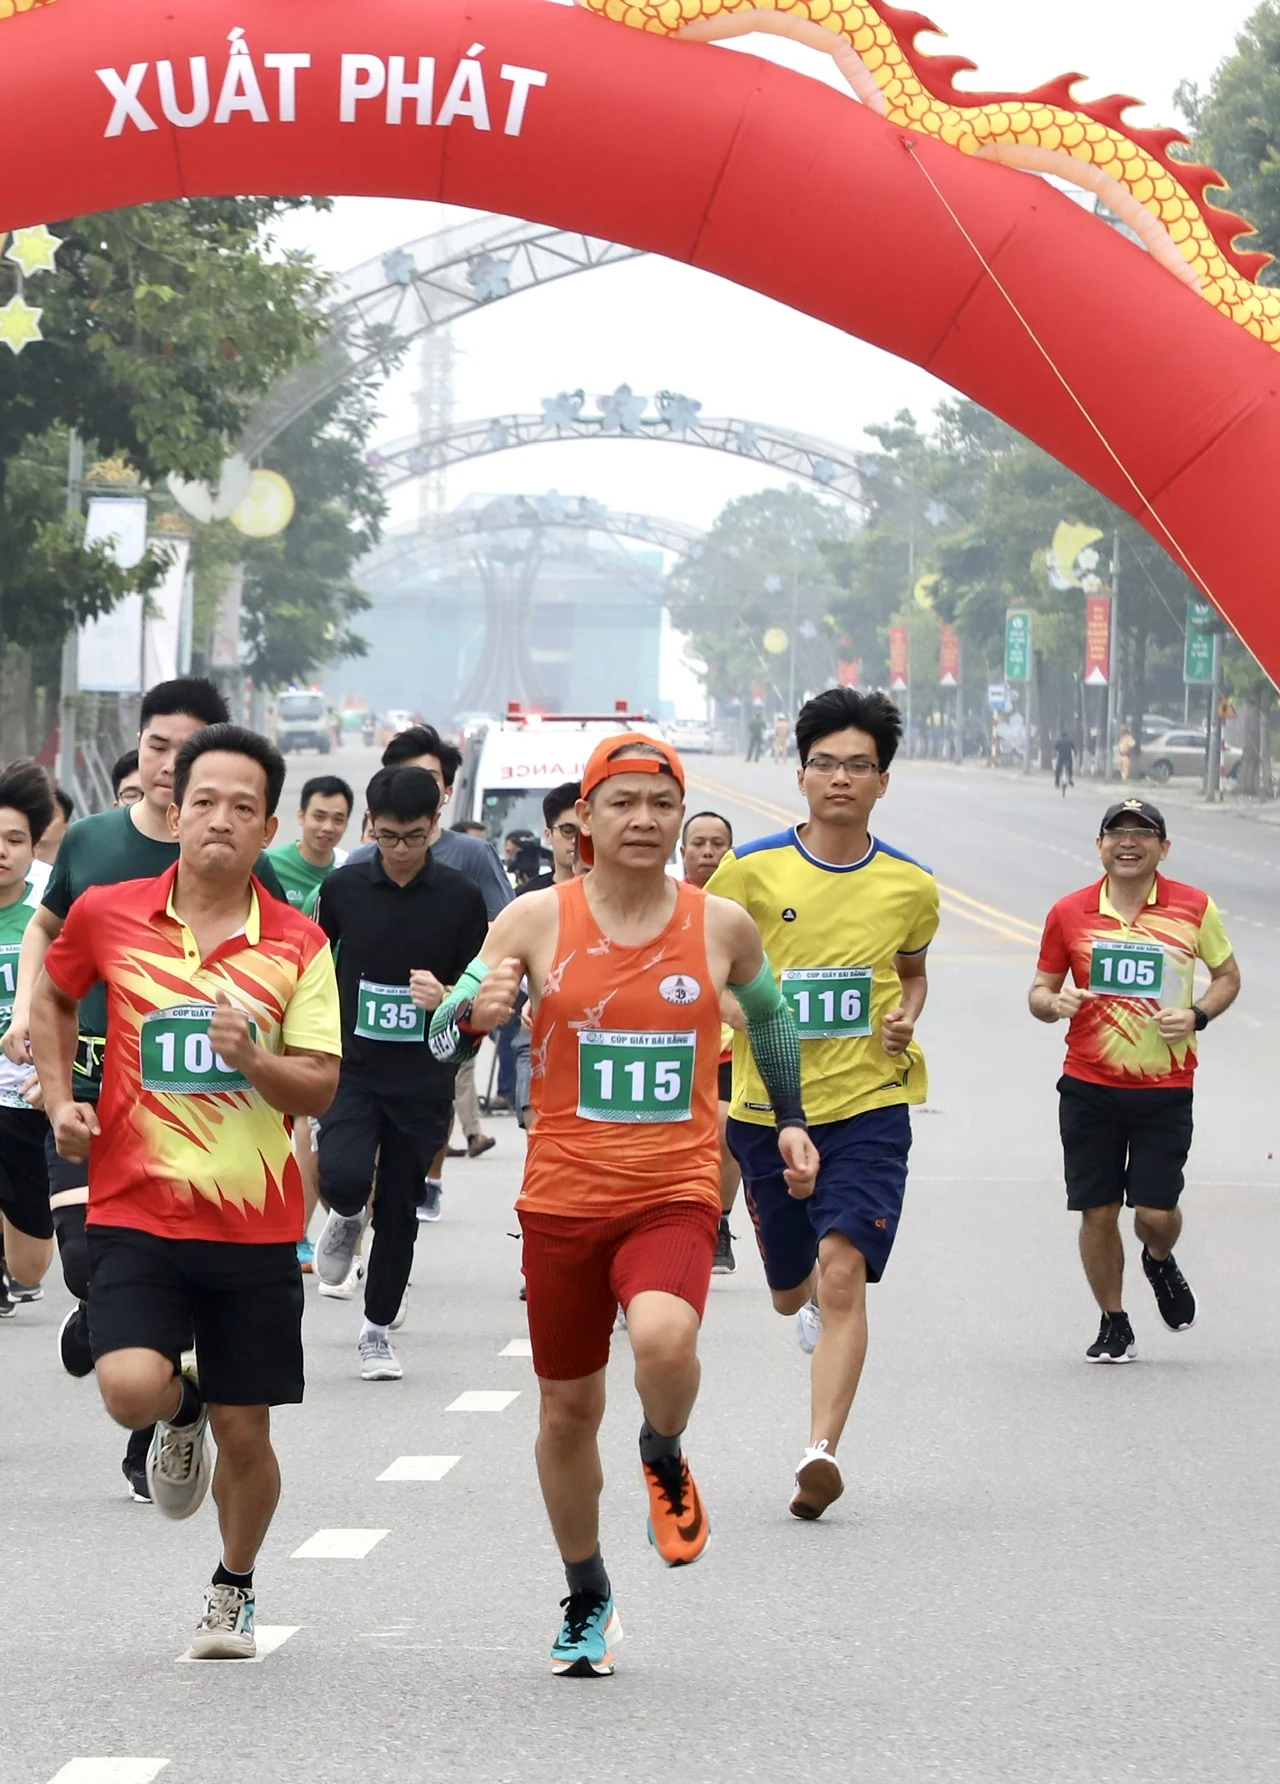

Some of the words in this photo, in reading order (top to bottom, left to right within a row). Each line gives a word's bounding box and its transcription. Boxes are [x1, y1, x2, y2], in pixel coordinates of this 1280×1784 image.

[94, 26, 311, 138] XUẤT
[339, 42, 548, 137] PHÁT
[1100, 958, 1154, 985] 105
[365, 1000, 417, 1029] 135
[793, 989, 861, 1023] 116
[593, 1060, 681, 1102] 115
